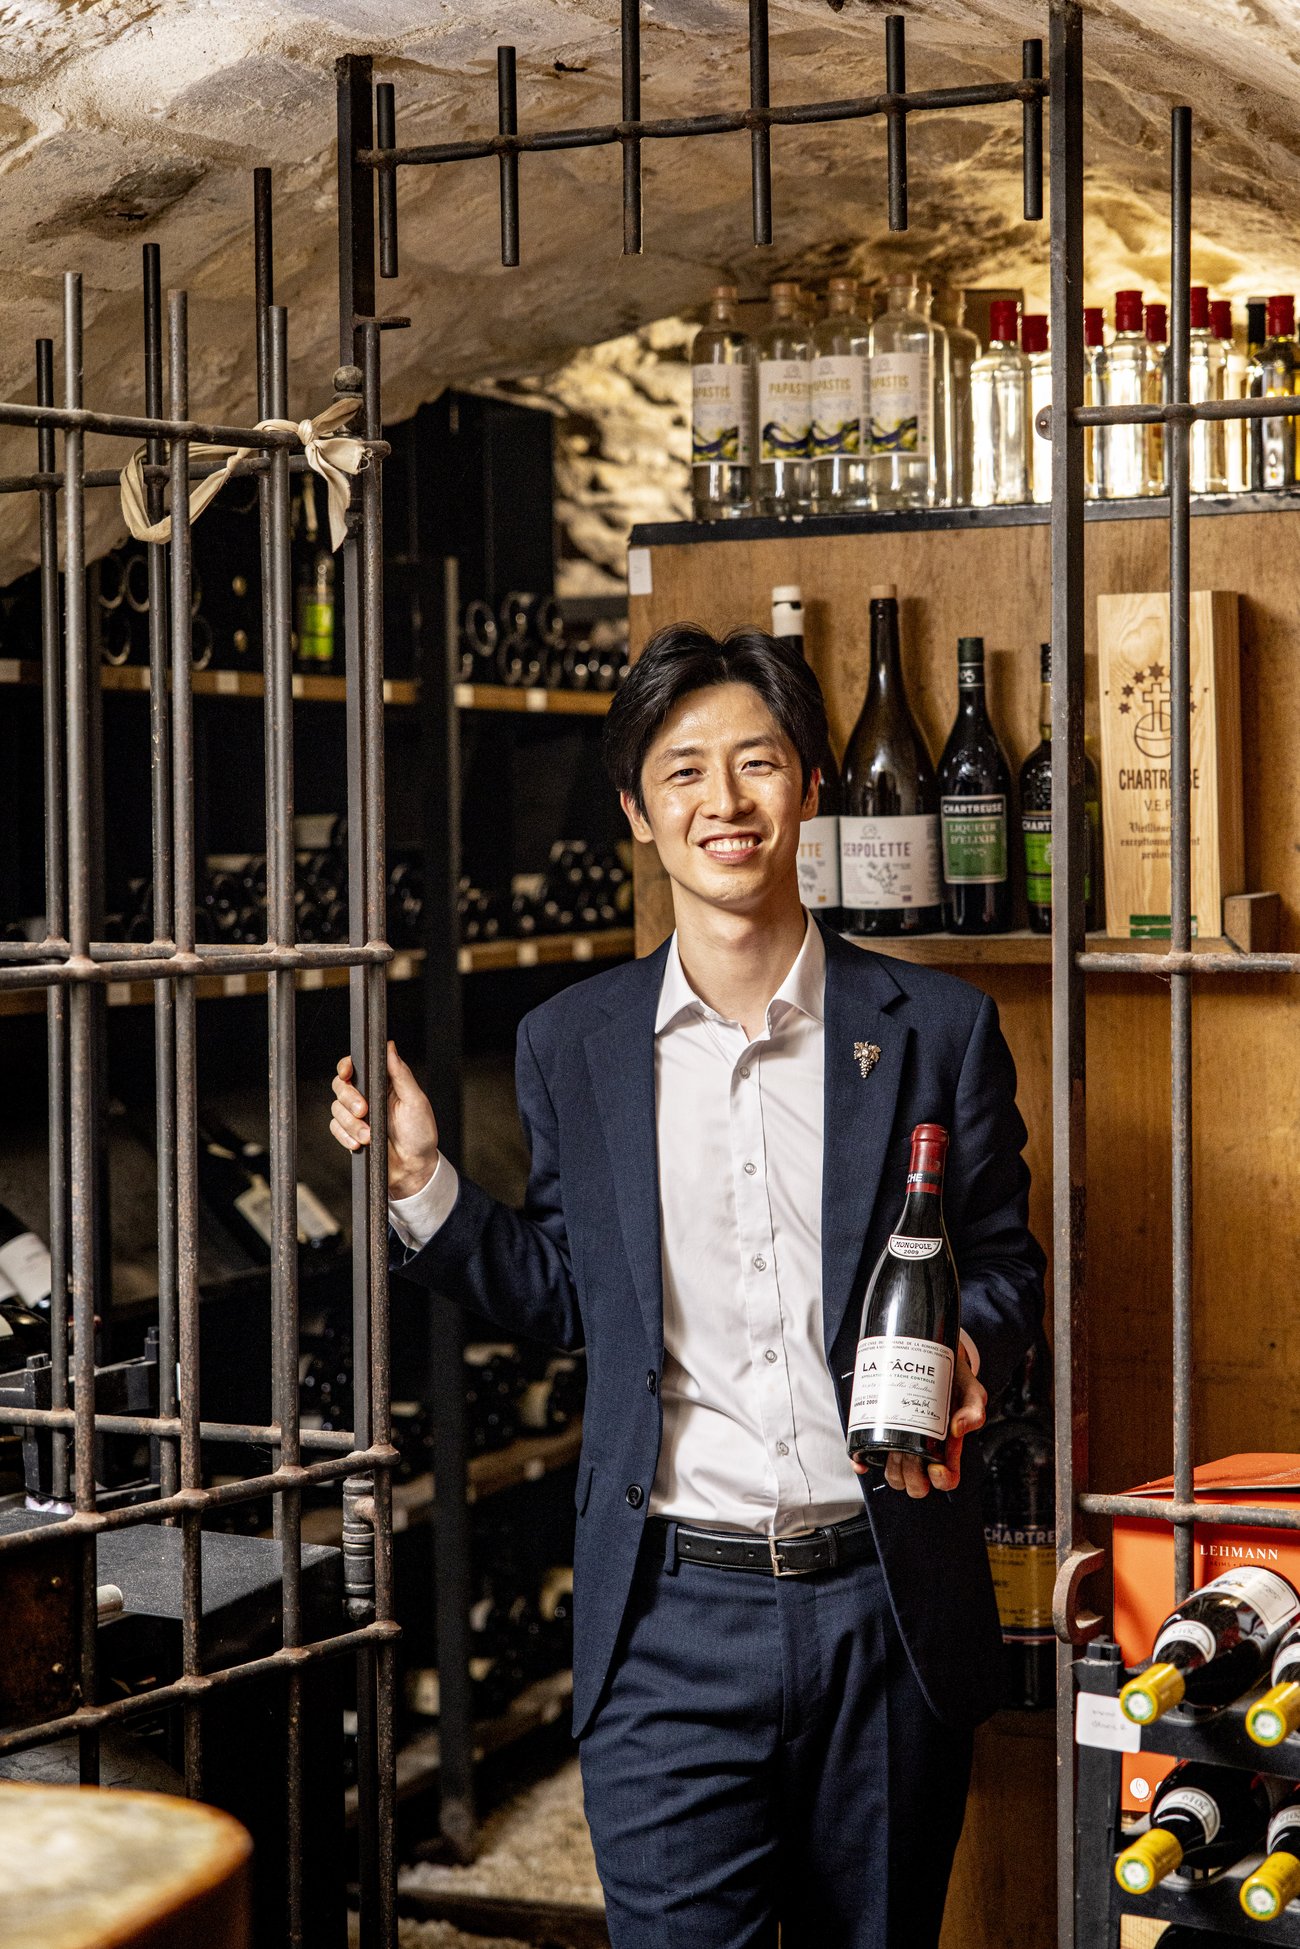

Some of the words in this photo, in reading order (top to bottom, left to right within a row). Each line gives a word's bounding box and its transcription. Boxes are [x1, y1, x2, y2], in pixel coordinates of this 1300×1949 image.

[1118, 768, 1200, 791] CHARTRE
[942, 802, 1003, 815] CHARTREUSE
[1022, 820, 1052, 832] CHART
[862, 1361, 878, 1373] LA
[984, 1526, 1056, 1544] CHARTRE
[1200, 1543, 1279, 1561] LEHMANN
